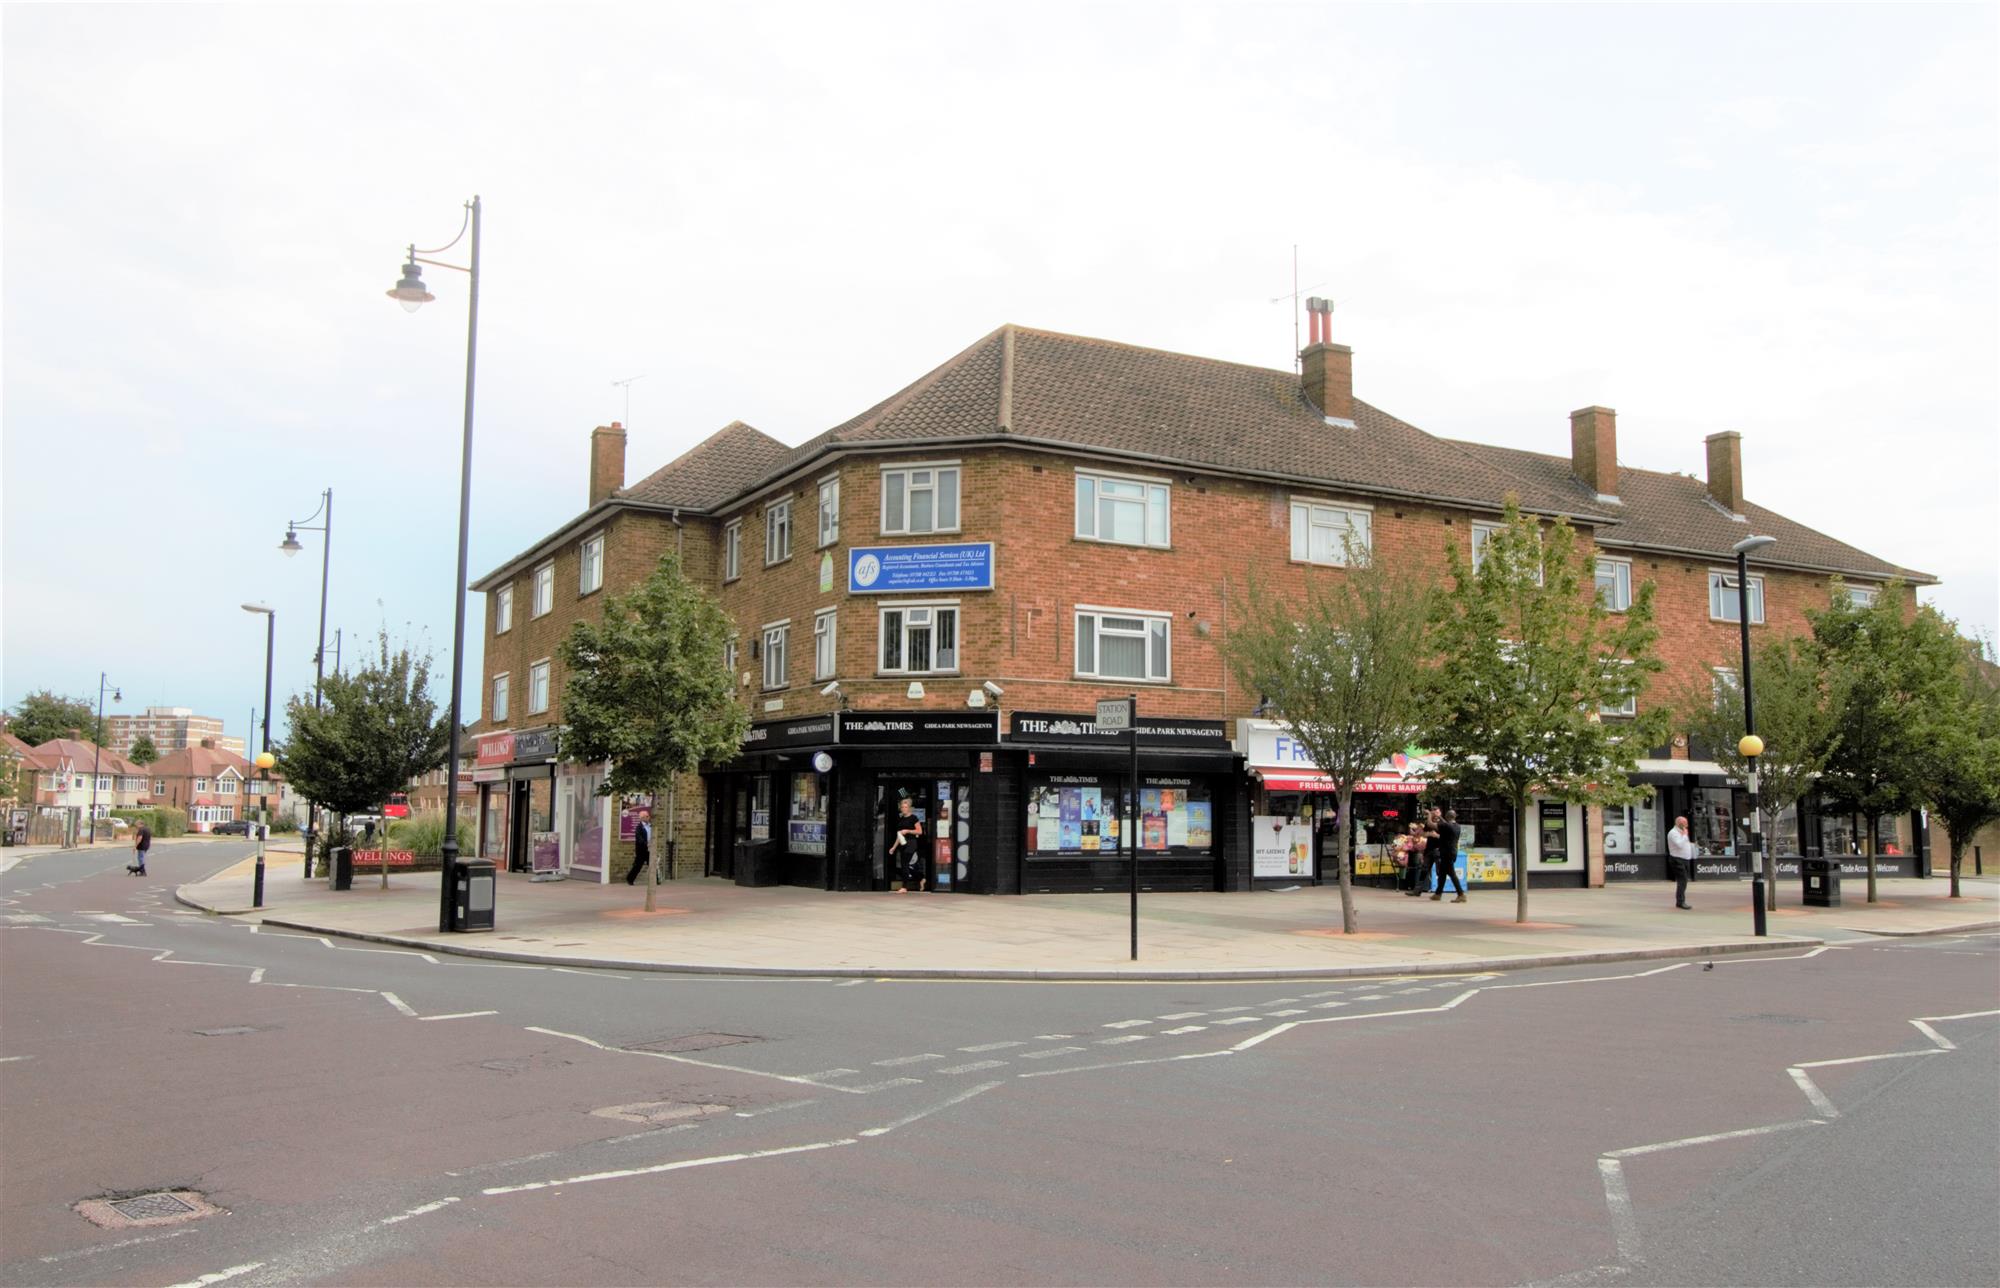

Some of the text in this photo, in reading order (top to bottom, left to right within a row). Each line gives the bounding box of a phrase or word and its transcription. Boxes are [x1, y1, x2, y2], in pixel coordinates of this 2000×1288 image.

[883, 549, 986, 563] Accounting Financial Services (UK) Ltd
[858, 560, 876, 580] afs
[1098, 703, 1128, 714] STATION
[845, 721, 864, 731] THE
[885, 721, 914, 731] TIMES
[1103, 716, 1123, 726] ROAD
[752, 728, 768, 741] TIMES
[808, 722, 832, 733] NEWSAGENTS
[1020, 719, 1049, 733] THE
[1157, 727, 1176, 735] PARK
[1176, 728, 1223, 737] NEWSAGENTS
[1049, 775, 1099, 784] THE TIMES
[1145, 777, 1191, 786] THE TIMES
[1367, 783, 1374, 791] &
[1376, 783, 1397, 791] WINE
[353, 851, 413, 861] WELLINGS
[1614, 863, 1639, 874] Fittings
[1697, 864, 1737, 875] Security Locks
[1779, 863, 1799, 874] Cutting
[1840, 863, 1855, 873] Trade
[1877, 863, 1899, 873] Welcome
